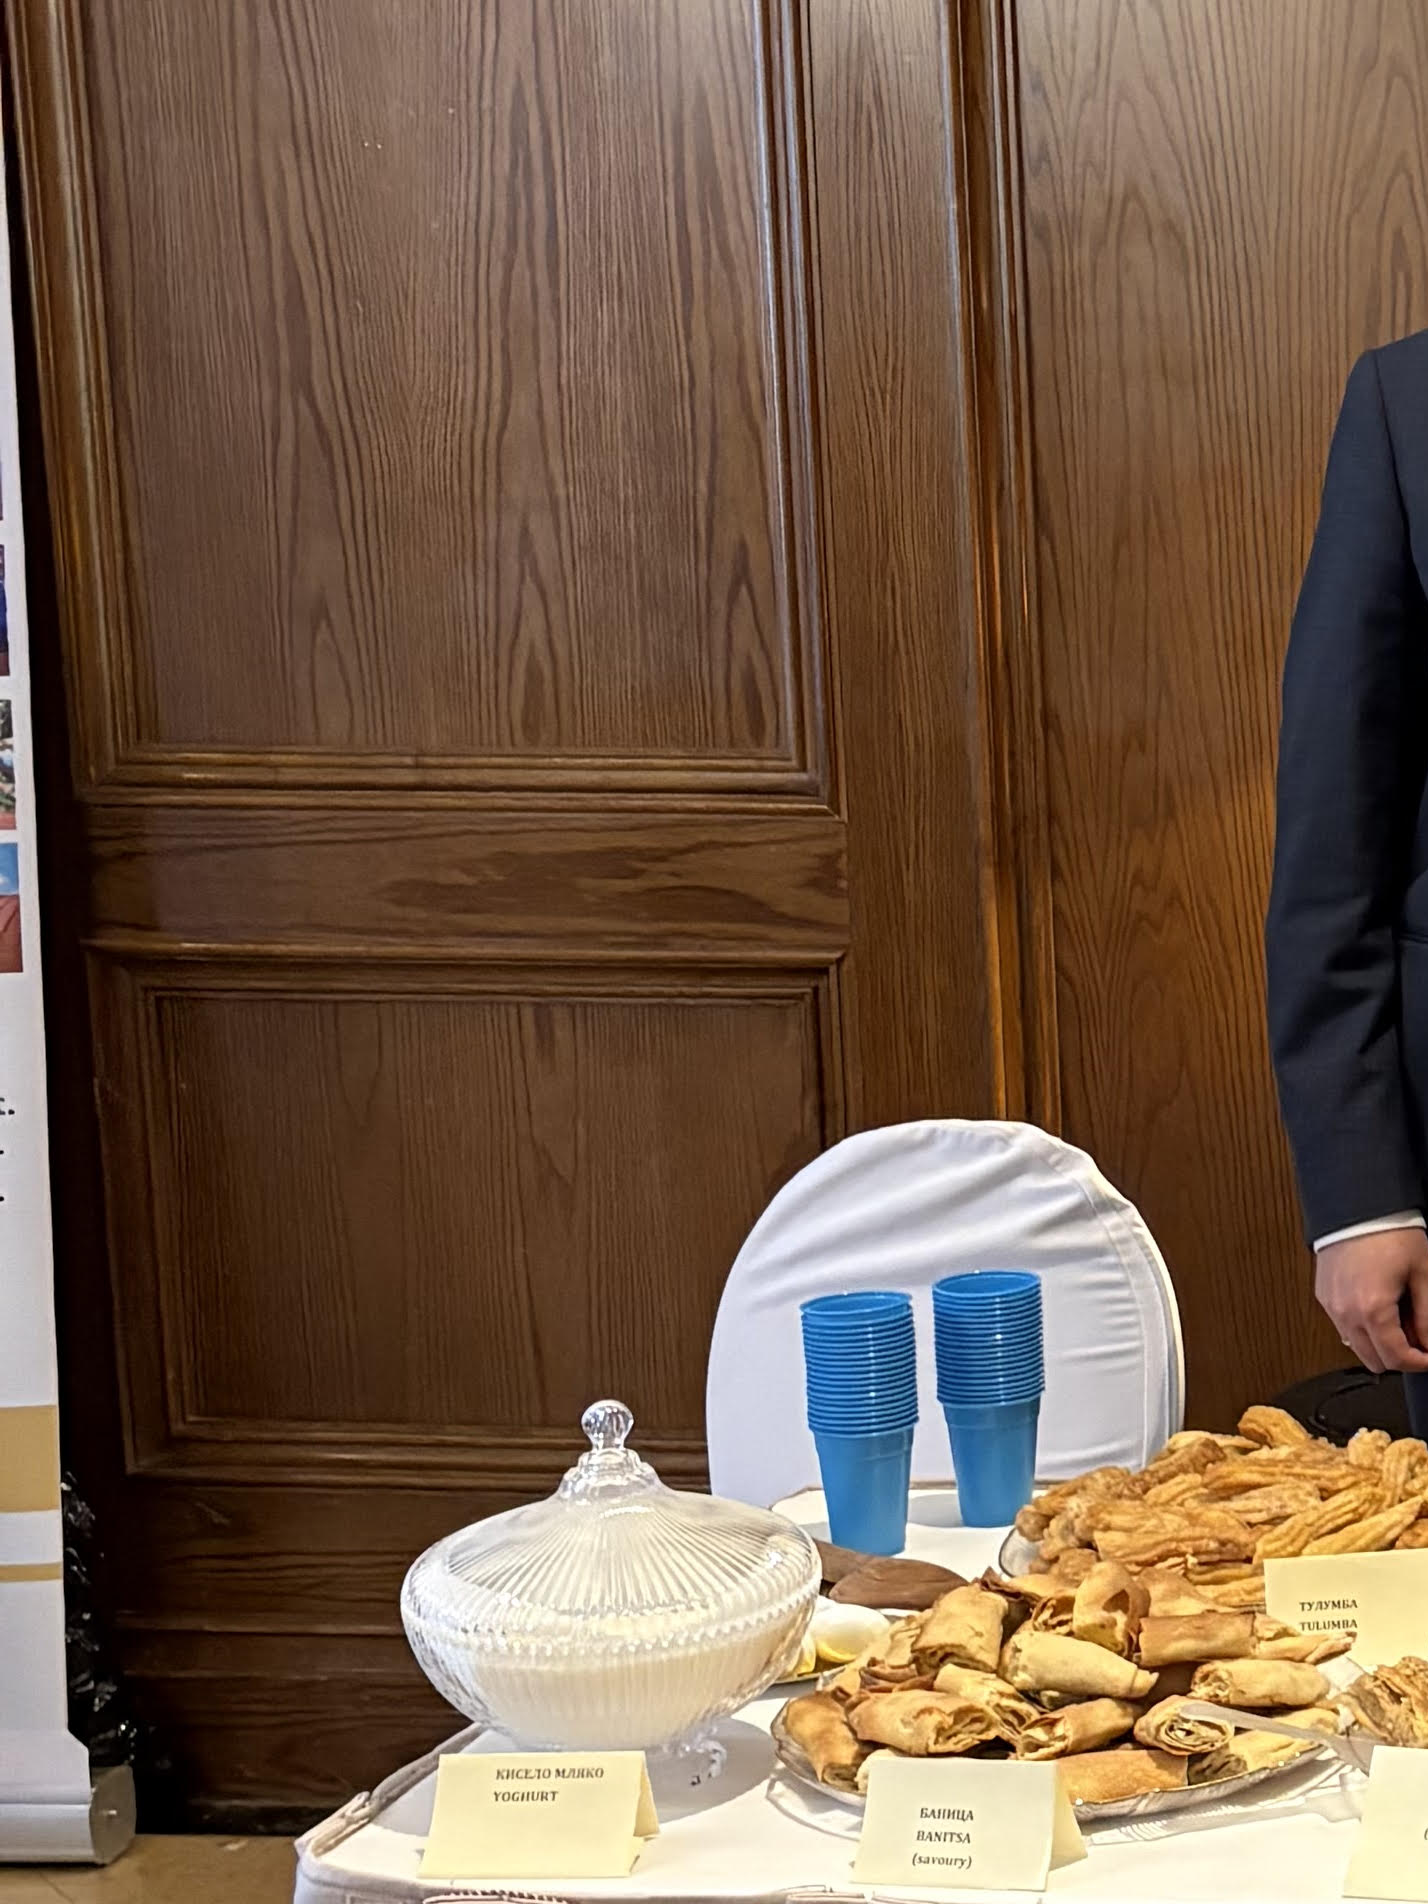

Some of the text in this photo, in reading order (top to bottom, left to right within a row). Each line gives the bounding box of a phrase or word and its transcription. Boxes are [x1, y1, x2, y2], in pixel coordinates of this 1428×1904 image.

[495, 1768, 552, 1781] КИСЕЛО
[493, 1790, 559, 1802] YOGHURT
[919, 1807, 974, 1822] БАНИЦА
[916, 1829, 971, 1844] BANITSA
[912, 1852, 973, 1870] (savoury)
